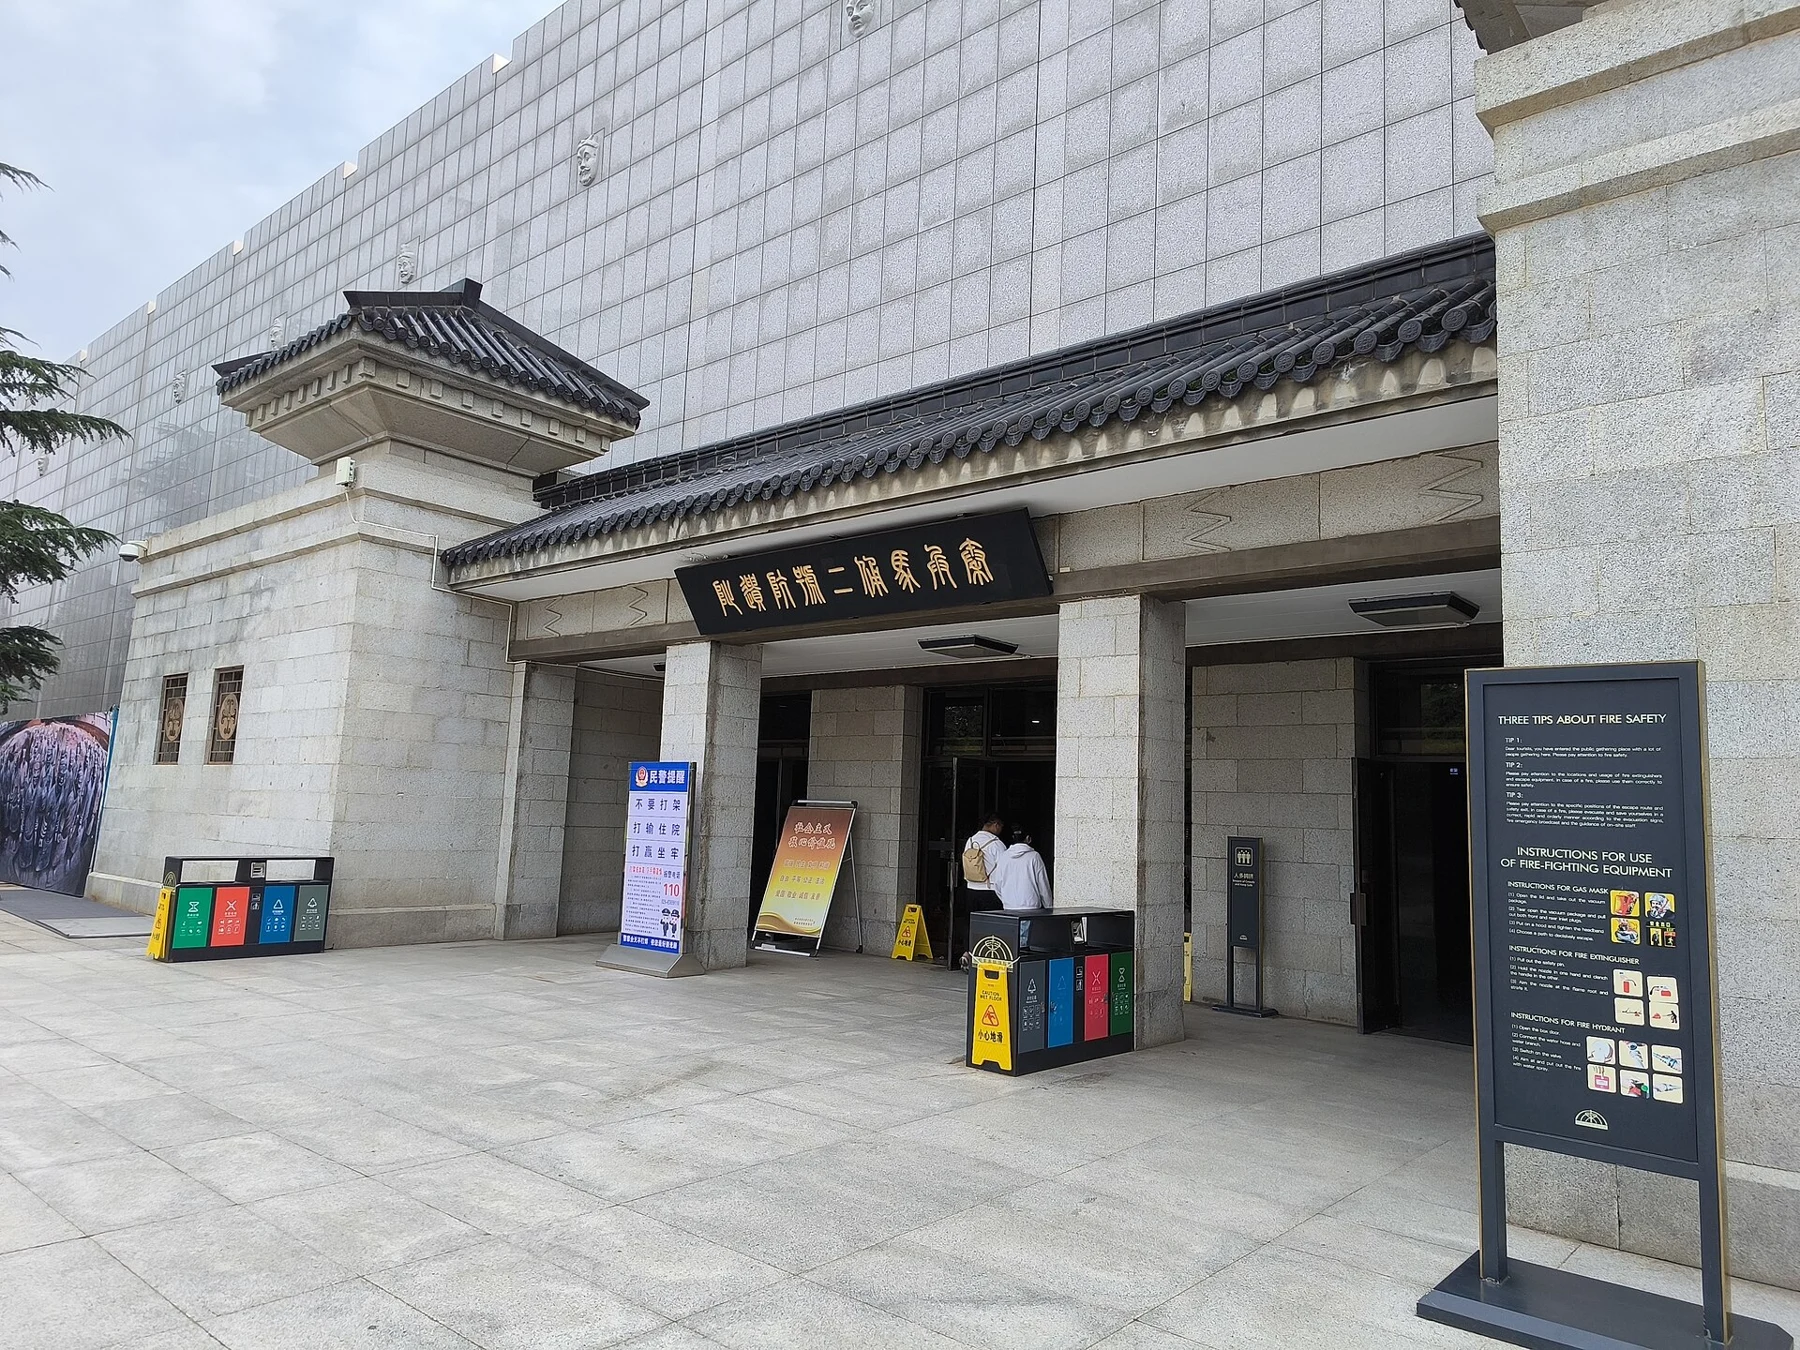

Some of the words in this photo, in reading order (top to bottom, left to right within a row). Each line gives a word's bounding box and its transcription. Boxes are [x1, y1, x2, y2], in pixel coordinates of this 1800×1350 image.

[1498, 715, 1528, 724] THREE
[1532, 715, 1553, 724] TIPS
[1556, 714, 1596, 724] ABOUT
[1599, 714, 1621, 723] FIRE
[1625, 713, 1666, 723] SAFETY
[650, 770, 685, 784] 民警提醒
[635, 799, 680, 811] 不要打架
[634, 822, 680, 835] 打输住院
[794, 822, 832, 834] 社会主义
[632, 845, 679, 859] 打赢坐牢
[1517, 846, 1597, 860] INSTRUCTIONS
[1602, 851, 1625, 861] FOR
[1630, 853, 1652, 863] USE
[1500, 858, 1516, 867] OF
[1520, 859, 1598, 873] FIRE-FIGHTING
[1603, 864, 1672, 878] EQUIPMENT
[664, 883, 680, 897] 110
[1507, 881, 1554, 890] INSTRUCTIONS
[1509, 944, 1556, 955] INSTRUCTIONS
[1590, 953, 1639, 965] EXTINGUISHER
[1510, 1011, 1558, 1024] INSTRUCTIONS
[1560, 1018, 1574, 1026] FOR
[1592, 1023, 1625, 1034] HYDRANT
[978, 1030, 1003, 1044] 小心地滑
